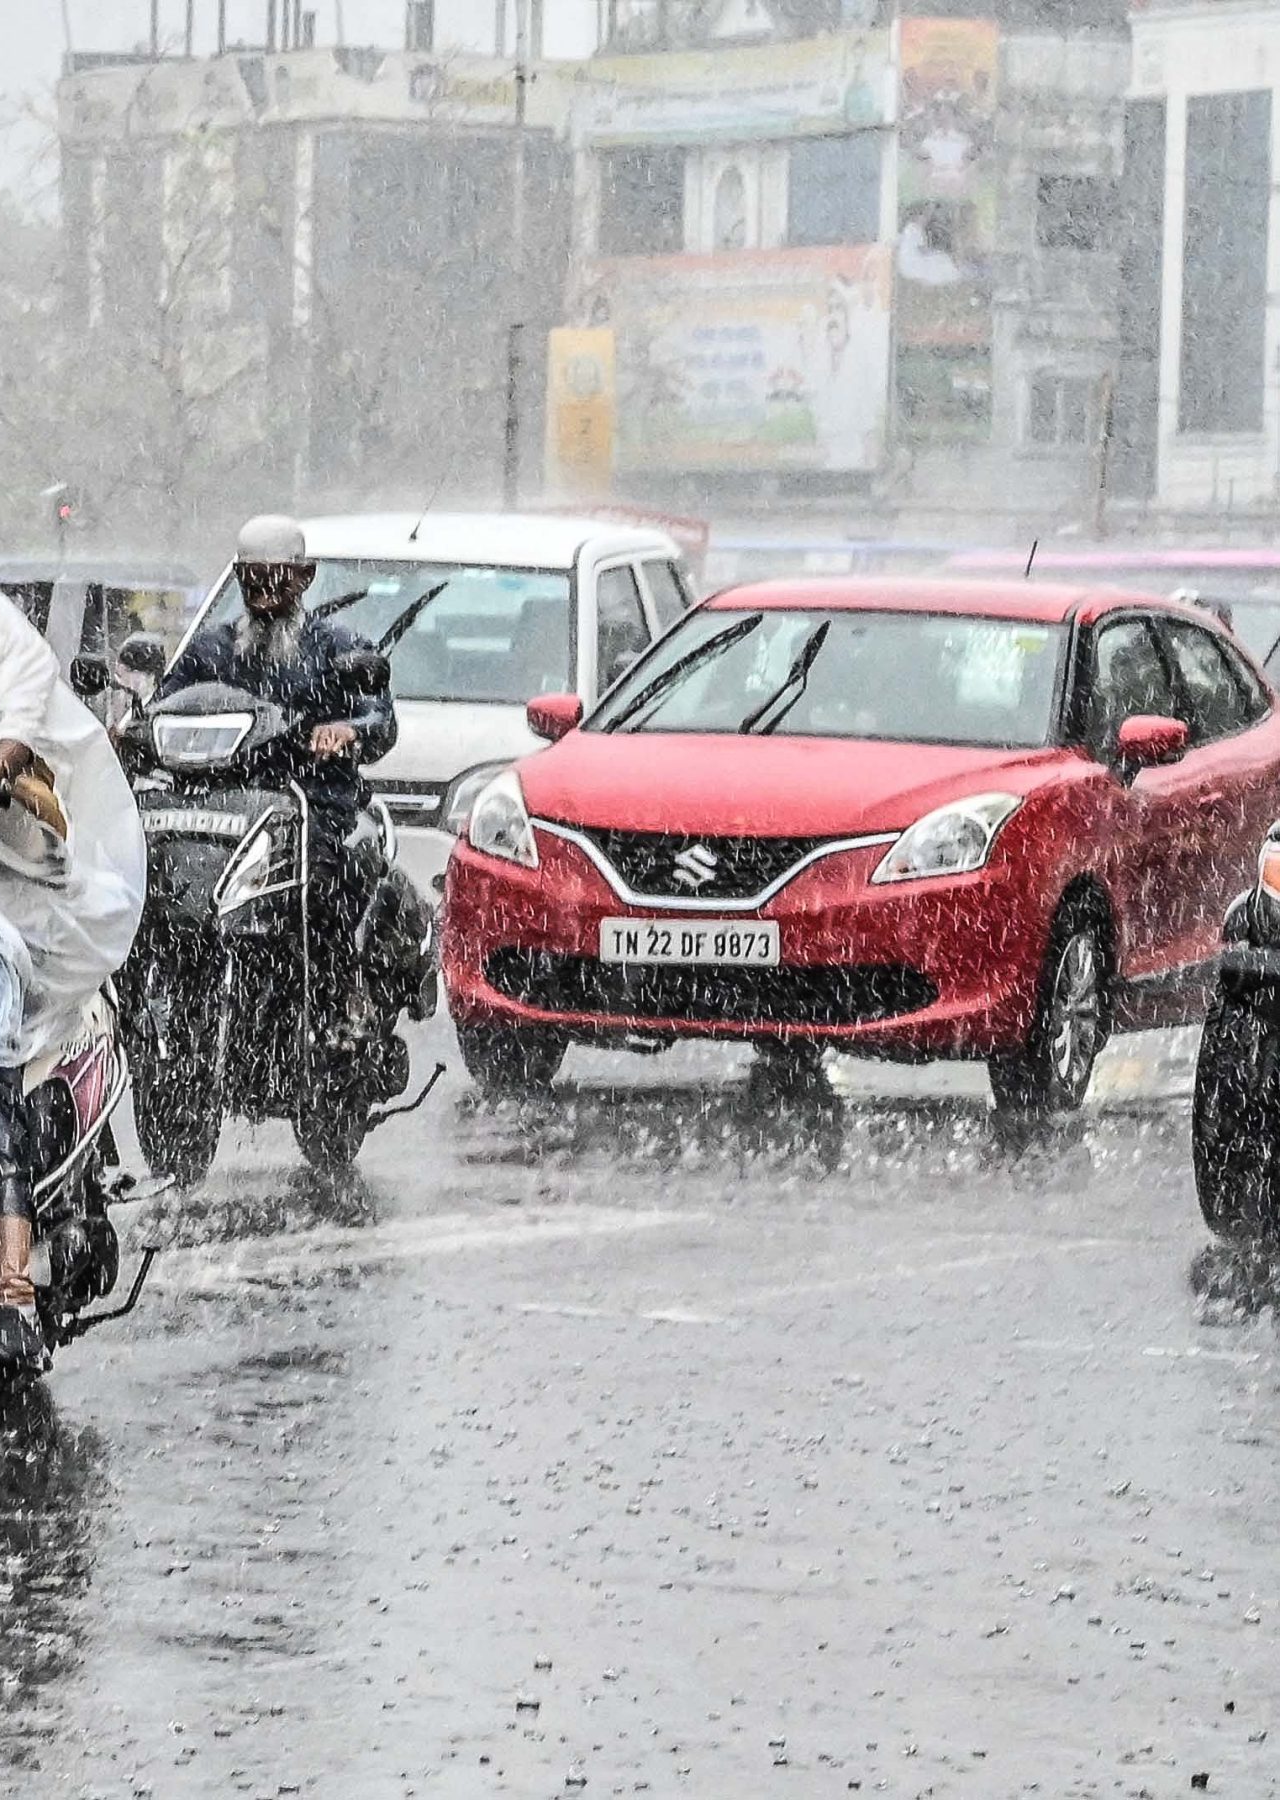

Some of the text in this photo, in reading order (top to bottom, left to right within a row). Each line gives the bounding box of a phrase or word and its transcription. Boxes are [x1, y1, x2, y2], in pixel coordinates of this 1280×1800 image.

[613, 930, 638, 956] TN
[647, 928, 672, 956] 22
[681, 932, 707, 957] DF
